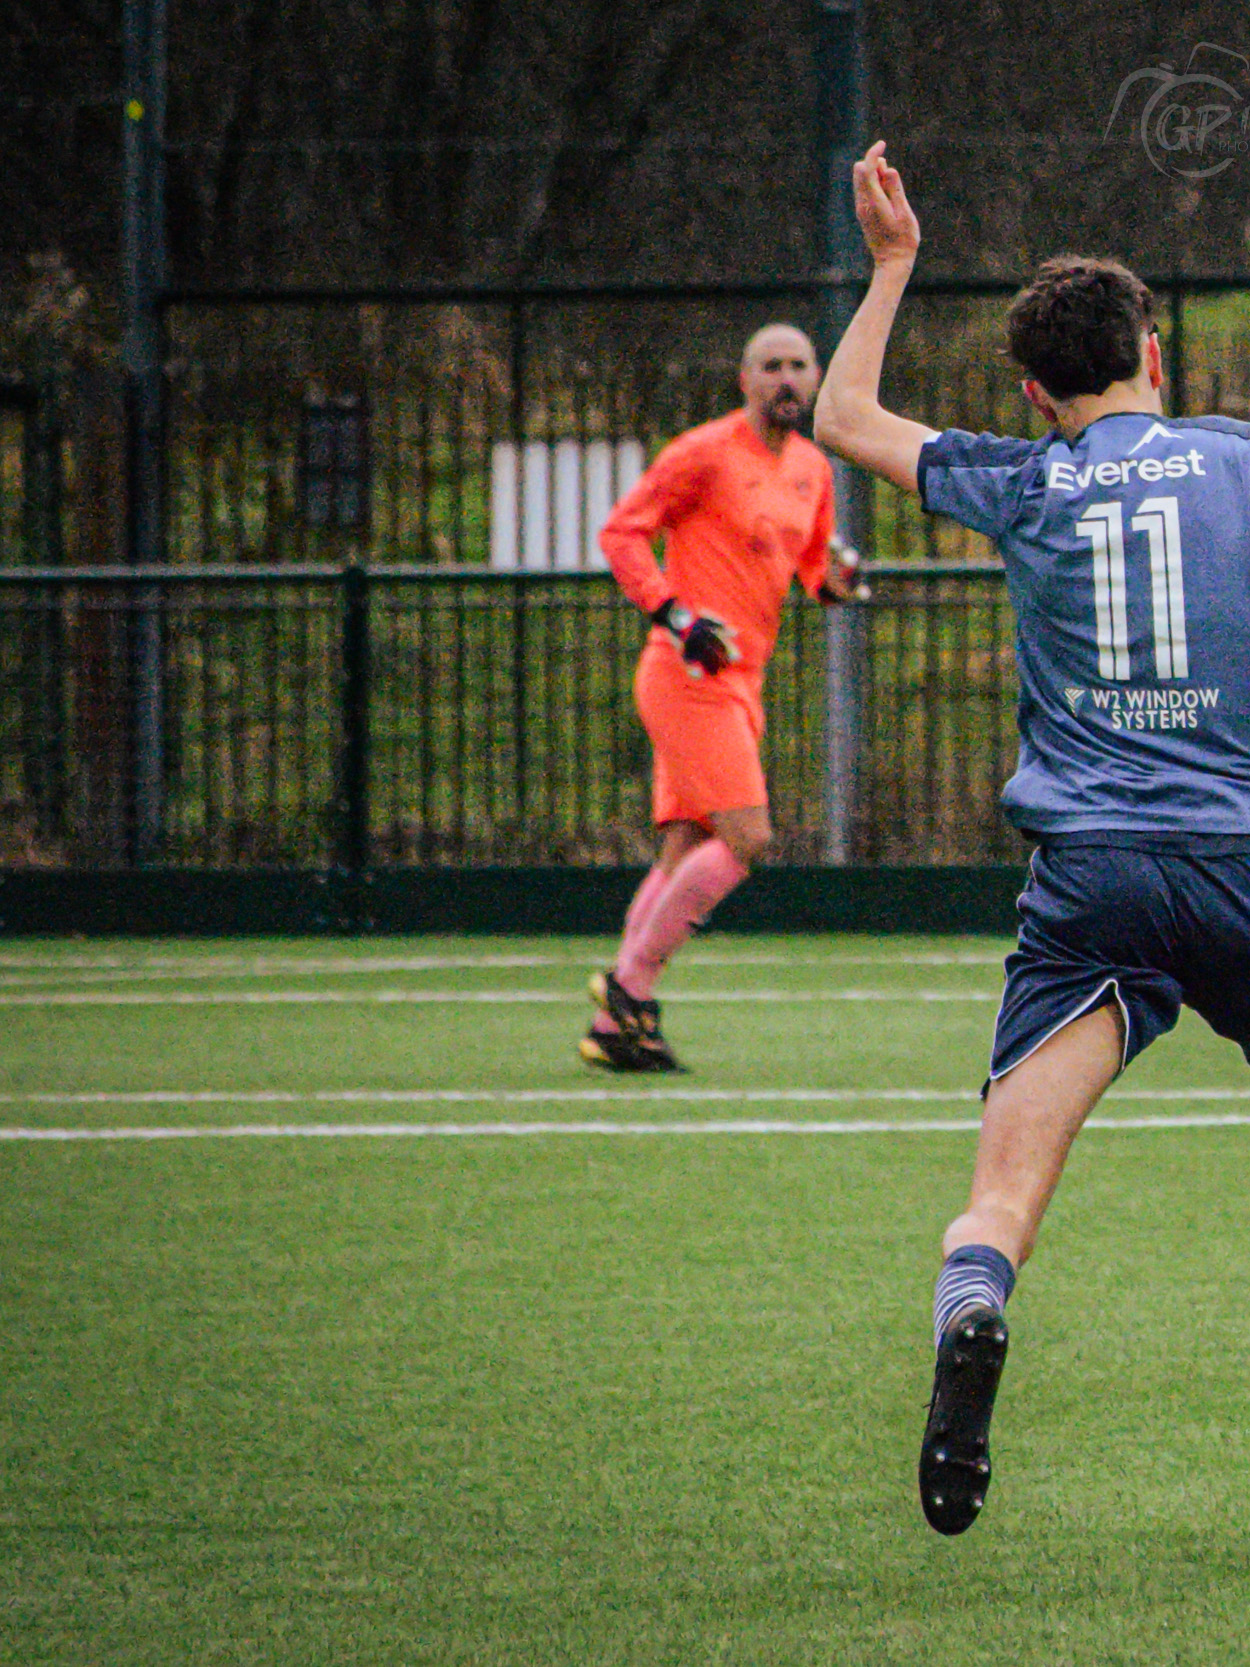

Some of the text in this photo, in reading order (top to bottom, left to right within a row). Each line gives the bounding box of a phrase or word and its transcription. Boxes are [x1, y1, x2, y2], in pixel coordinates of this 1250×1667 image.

[1048, 449, 1206, 491] Everest
[1076, 496, 1189, 680] 11
[1091, 688, 1219, 710] W2 WINDOW
[1112, 710, 1198, 730] SYSTEMS
